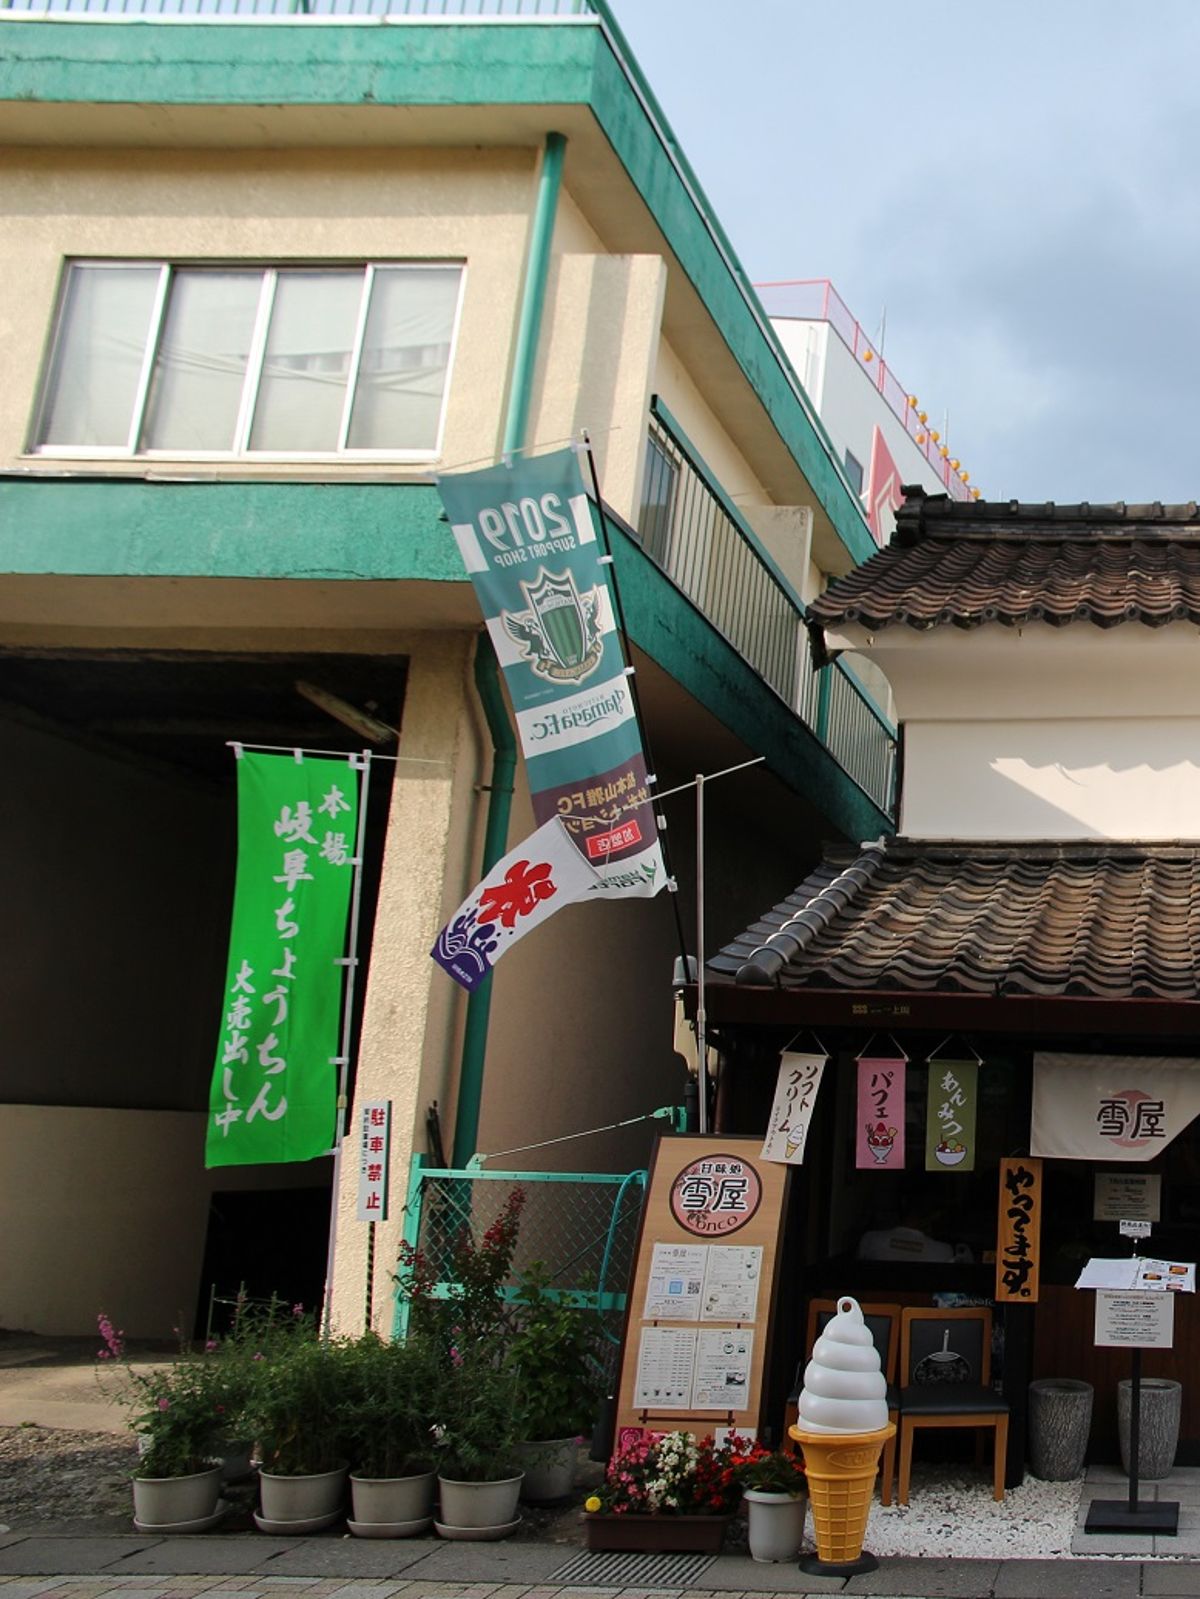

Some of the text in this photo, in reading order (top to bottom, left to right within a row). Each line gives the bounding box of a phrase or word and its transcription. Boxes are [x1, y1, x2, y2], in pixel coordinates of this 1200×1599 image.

[318, 785, 350, 865] 本場
[245, 801, 318, 1121] 岐阜ちょうちん
[214, 959, 256, 1137] 大売出し中
[778, 1069, 803, 1133] クリーム
[801, 1065, 819, 1112] ソフト
[871, 1071, 894, 1118] パフェ
[938, 1071, 967, 1136] あんみつ
[1097, 1100, 1166, 1139] 雪屋
[366, 1108, 385, 1209] 駐車禁止
[682, 1177, 748, 1211] 雪屋
[687, 1215, 739, 1232] Conco
[1002, 1166, 1034, 1297] やってます。
